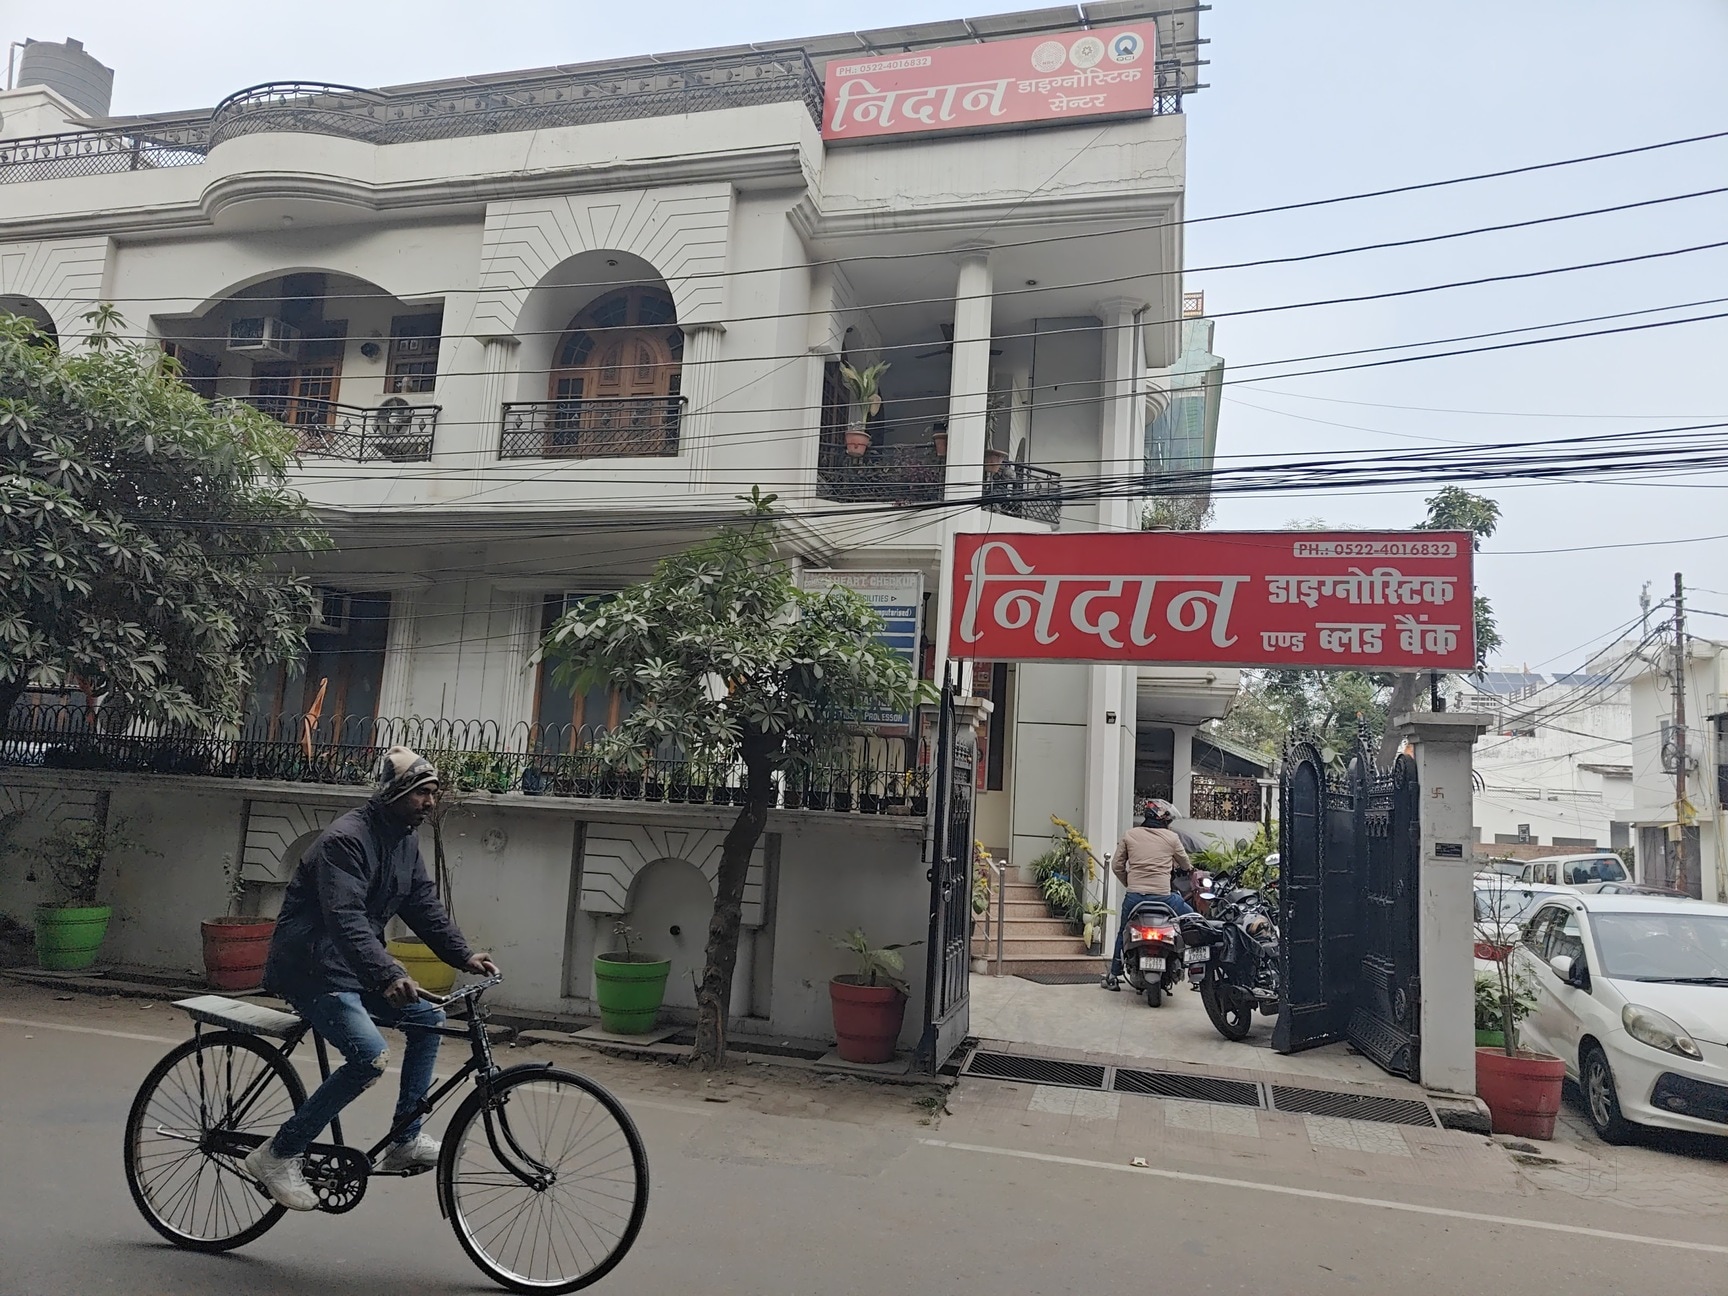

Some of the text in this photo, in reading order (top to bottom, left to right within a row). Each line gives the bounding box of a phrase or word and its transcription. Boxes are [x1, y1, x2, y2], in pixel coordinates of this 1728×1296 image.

[860, 58, 928, 73] 0522-4016832
[1017, 67, 1142, 94] डाइग्नोस्टिक
[831, 78, 1016, 132] निदान
[1048, 92, 1107, 112] सेन्टर
[1299, 543, 1451, 556] PH.: 0522-4016832
[959, 541, 1251, 649] निदान
[1265, 567, 1458, 609] डाइग्नोस्टिक
[1260, 613, 1461, 655] एण्ड ब्लड बैंक
